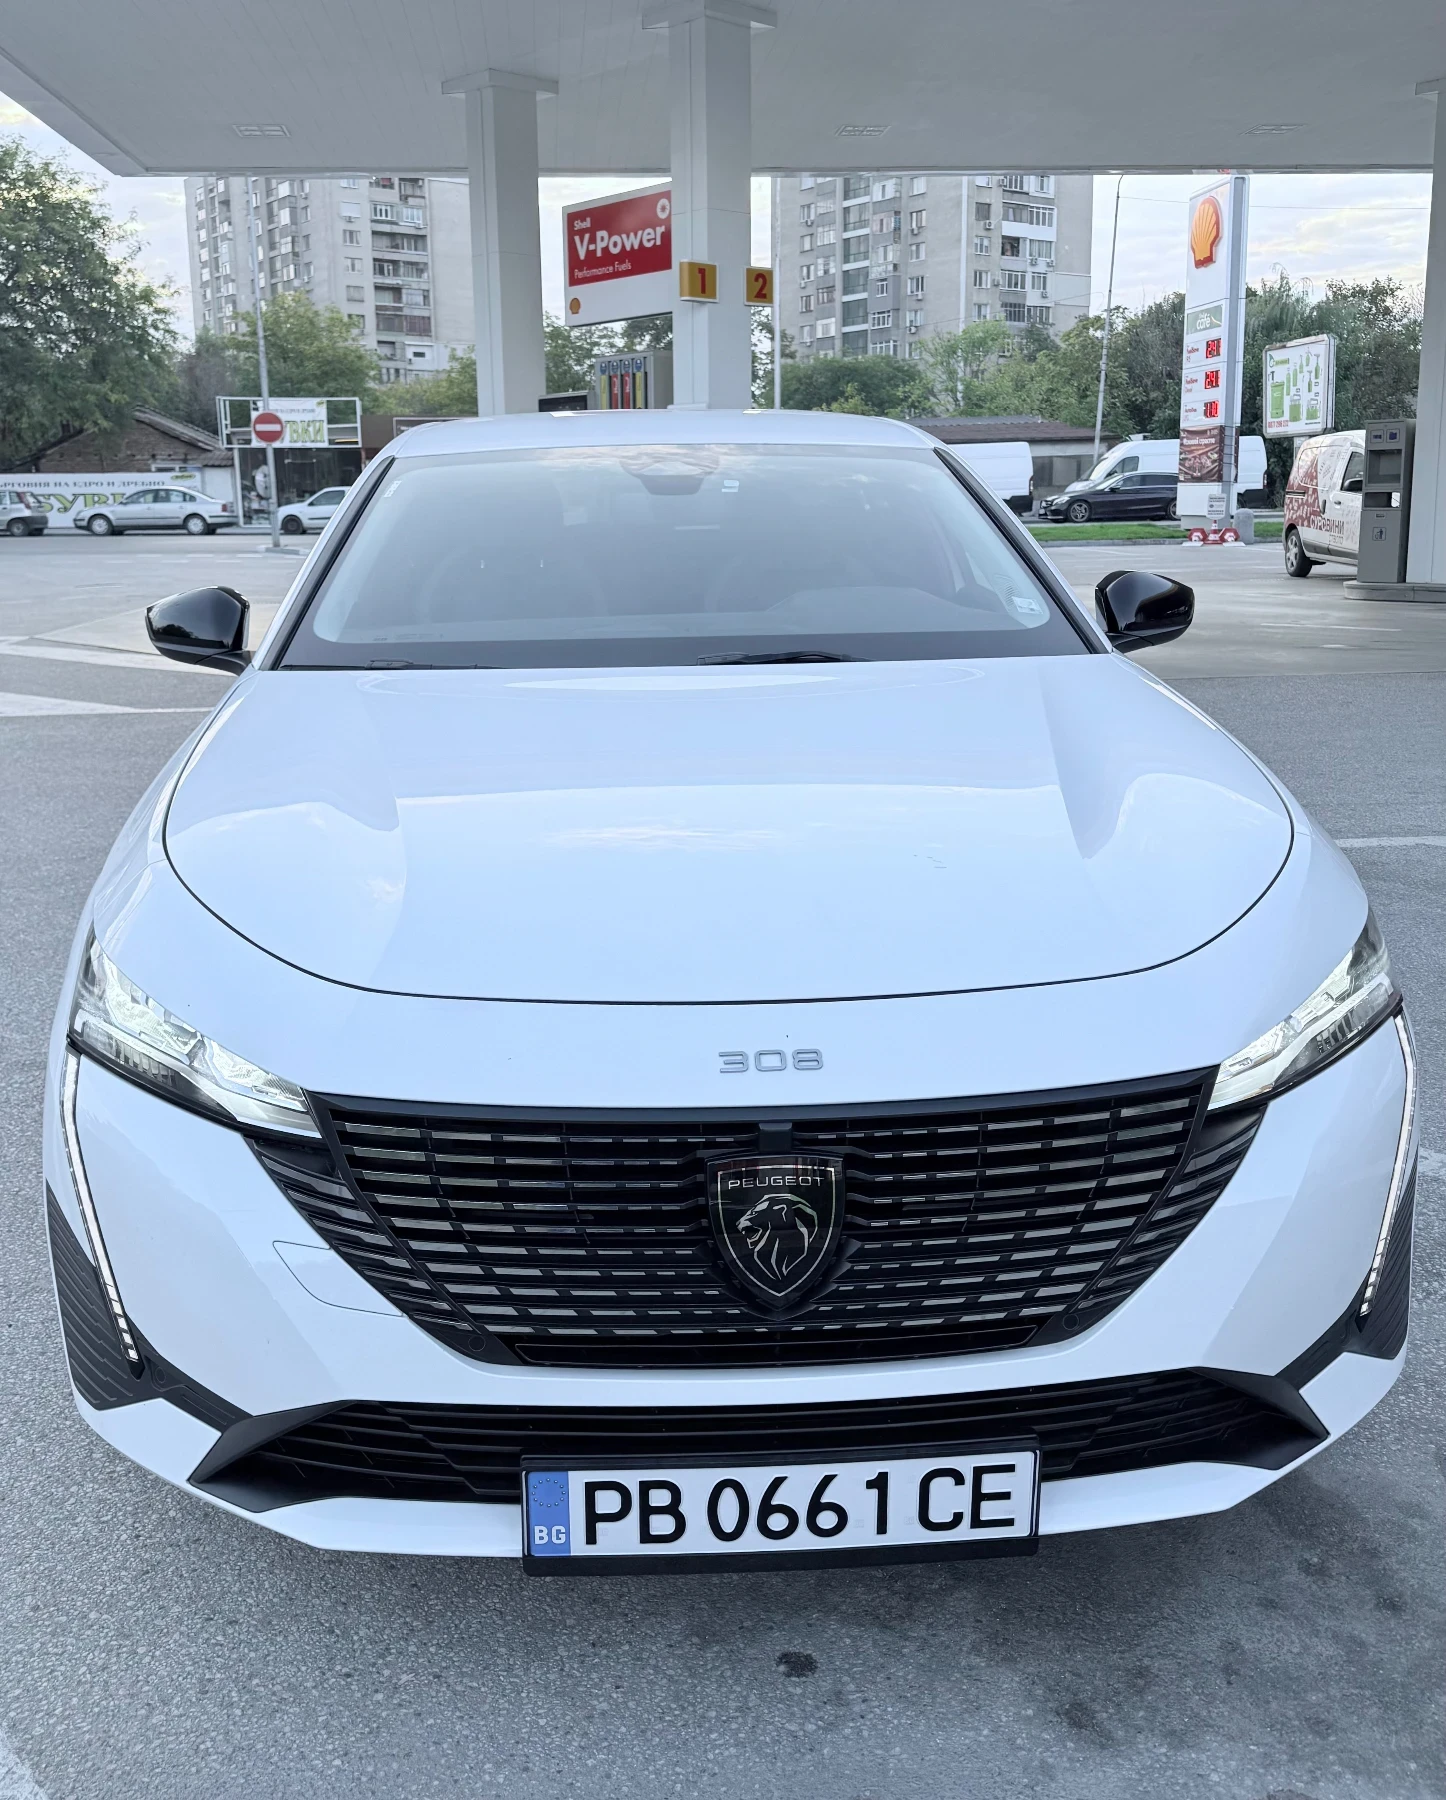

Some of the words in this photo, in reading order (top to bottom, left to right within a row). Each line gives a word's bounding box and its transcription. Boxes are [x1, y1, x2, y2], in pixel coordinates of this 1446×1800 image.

[574, 217, 591, 231] Shell
[574, 225, 666, 261] V-Power
[574, 265, 614, 279] Performance
[614, 259, 632, 272] Fuels
[697, 268, 706, 295] 1
[754, 272, 768, 300] 2
[1196, 313, 1211, 330] café
[1310, 514, 1345, 535] СУРОВИНИ
[718, 1048, 824, 1073] 308
[728, 1175, 825, 1190] PEUGEOT
[584, 1479, 687, 1545] PB
[707, 1471, 889, 1542] 0661
[917, 1463, 1016, 1531] CE
[534, 1525, 566, 1546] BG
